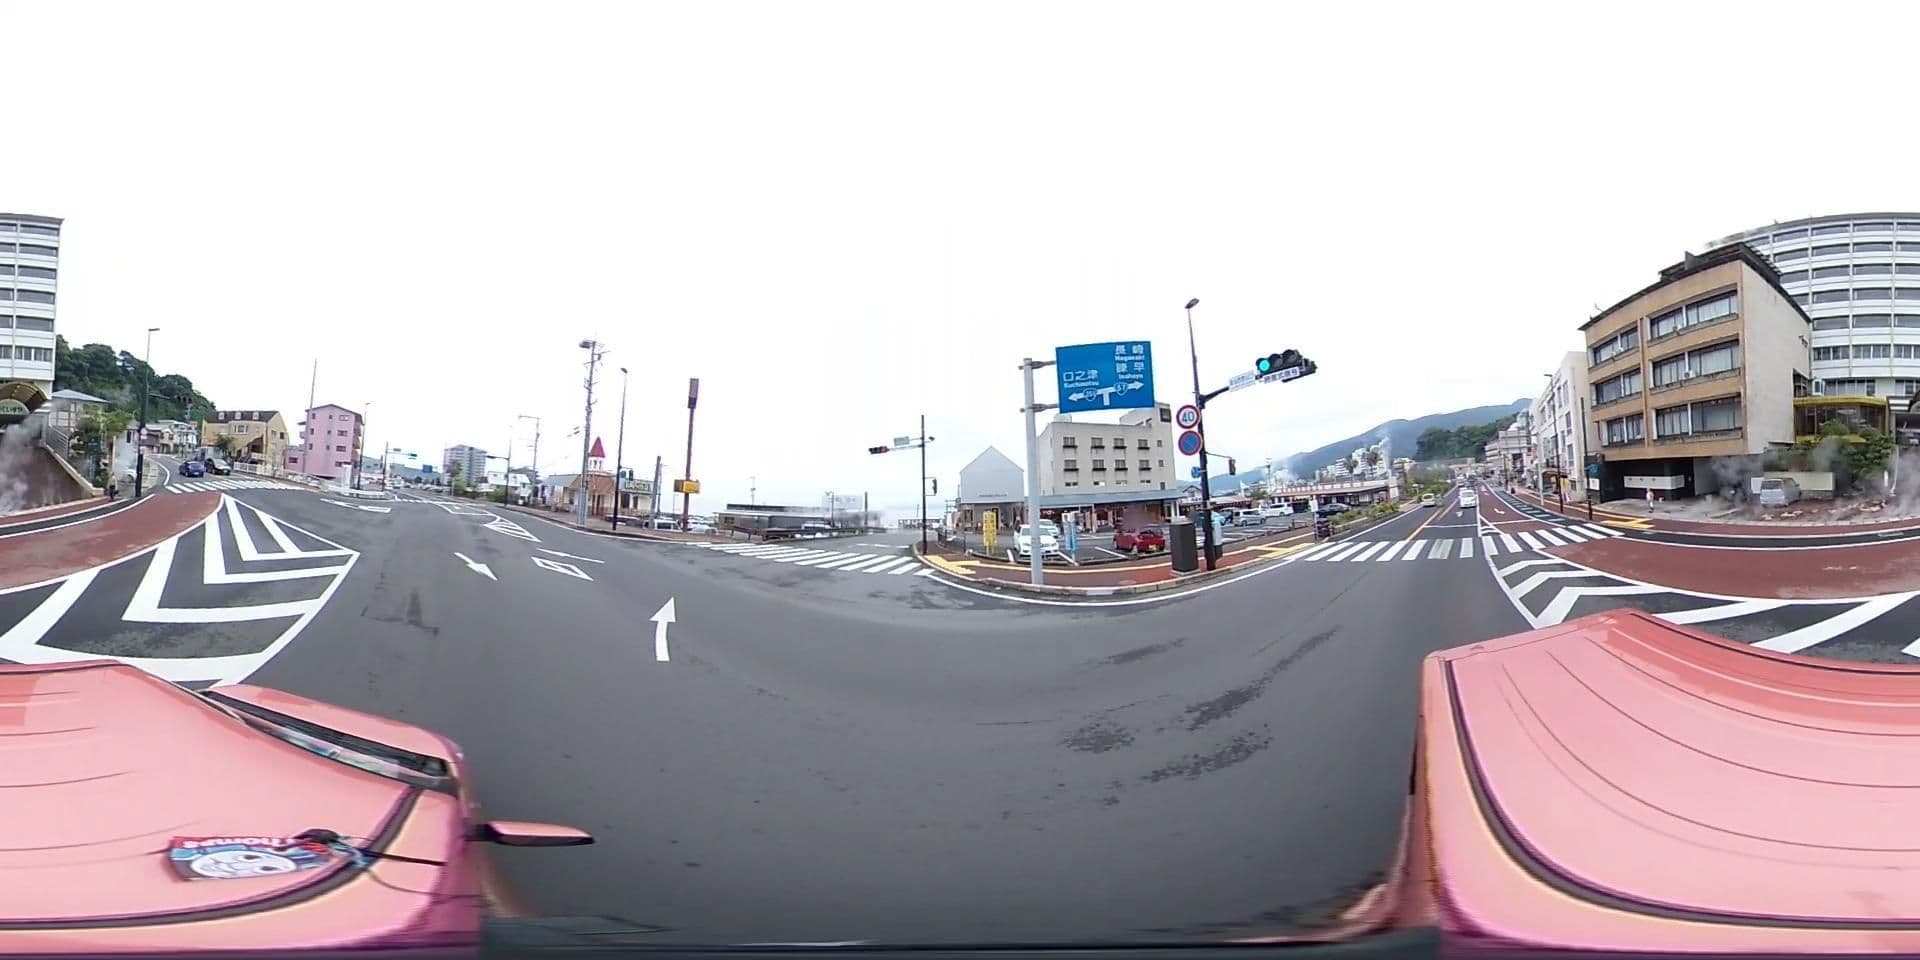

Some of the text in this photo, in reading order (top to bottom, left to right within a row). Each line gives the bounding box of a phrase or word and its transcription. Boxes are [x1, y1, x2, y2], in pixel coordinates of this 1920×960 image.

[1064, 369, 1099, 382] 口之津
[1182, 411, 1195, 423] 40
